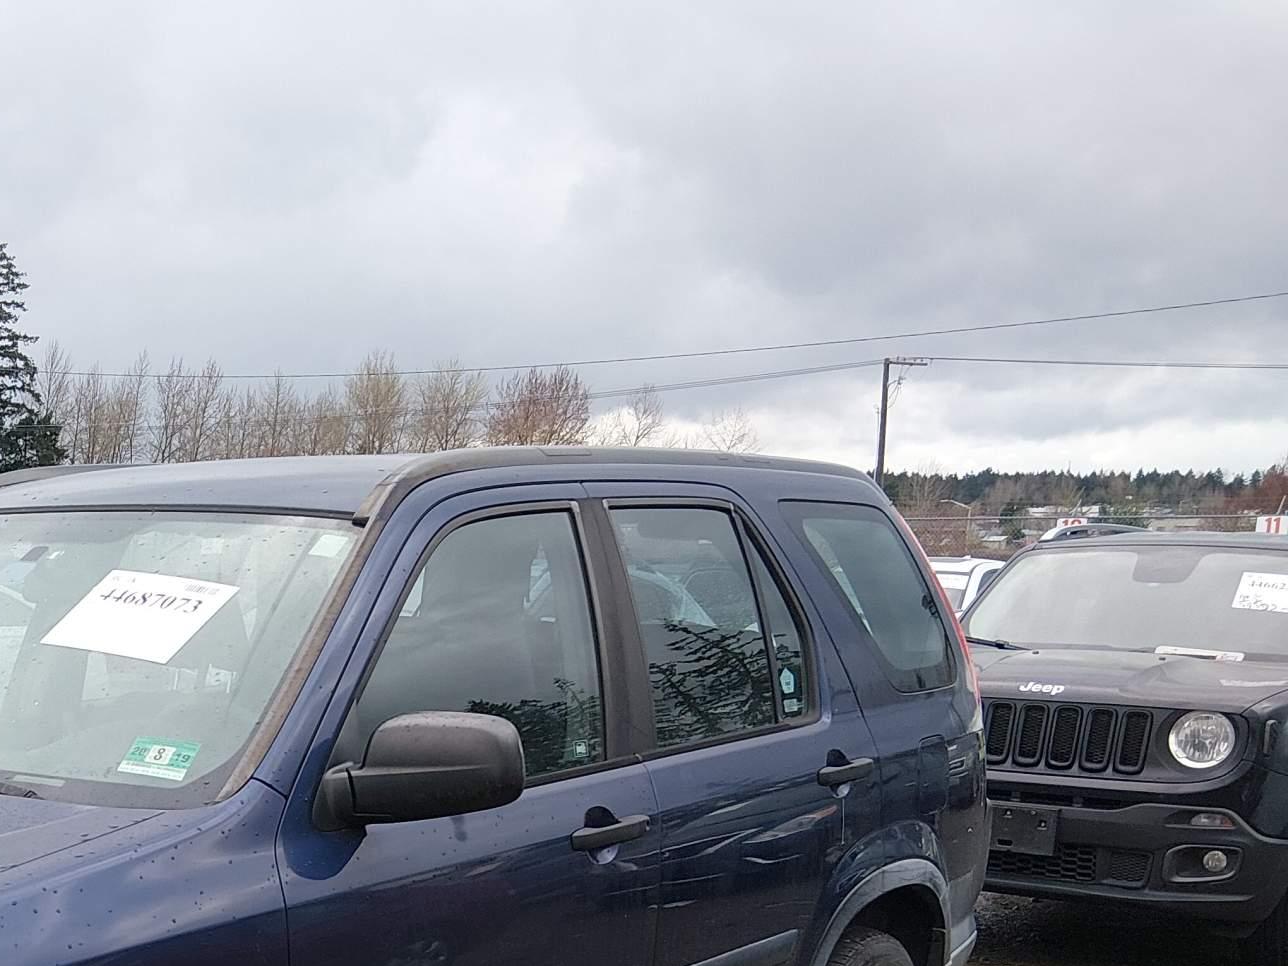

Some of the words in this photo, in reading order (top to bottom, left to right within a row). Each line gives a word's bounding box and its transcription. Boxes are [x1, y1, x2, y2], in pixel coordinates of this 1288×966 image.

[1265, 517, 1281, 534] 11
[100, 588, 203, 614] 44687073
[1018, 681, 1065, 696] Jeep
[153, 747, 166, 761] 8
